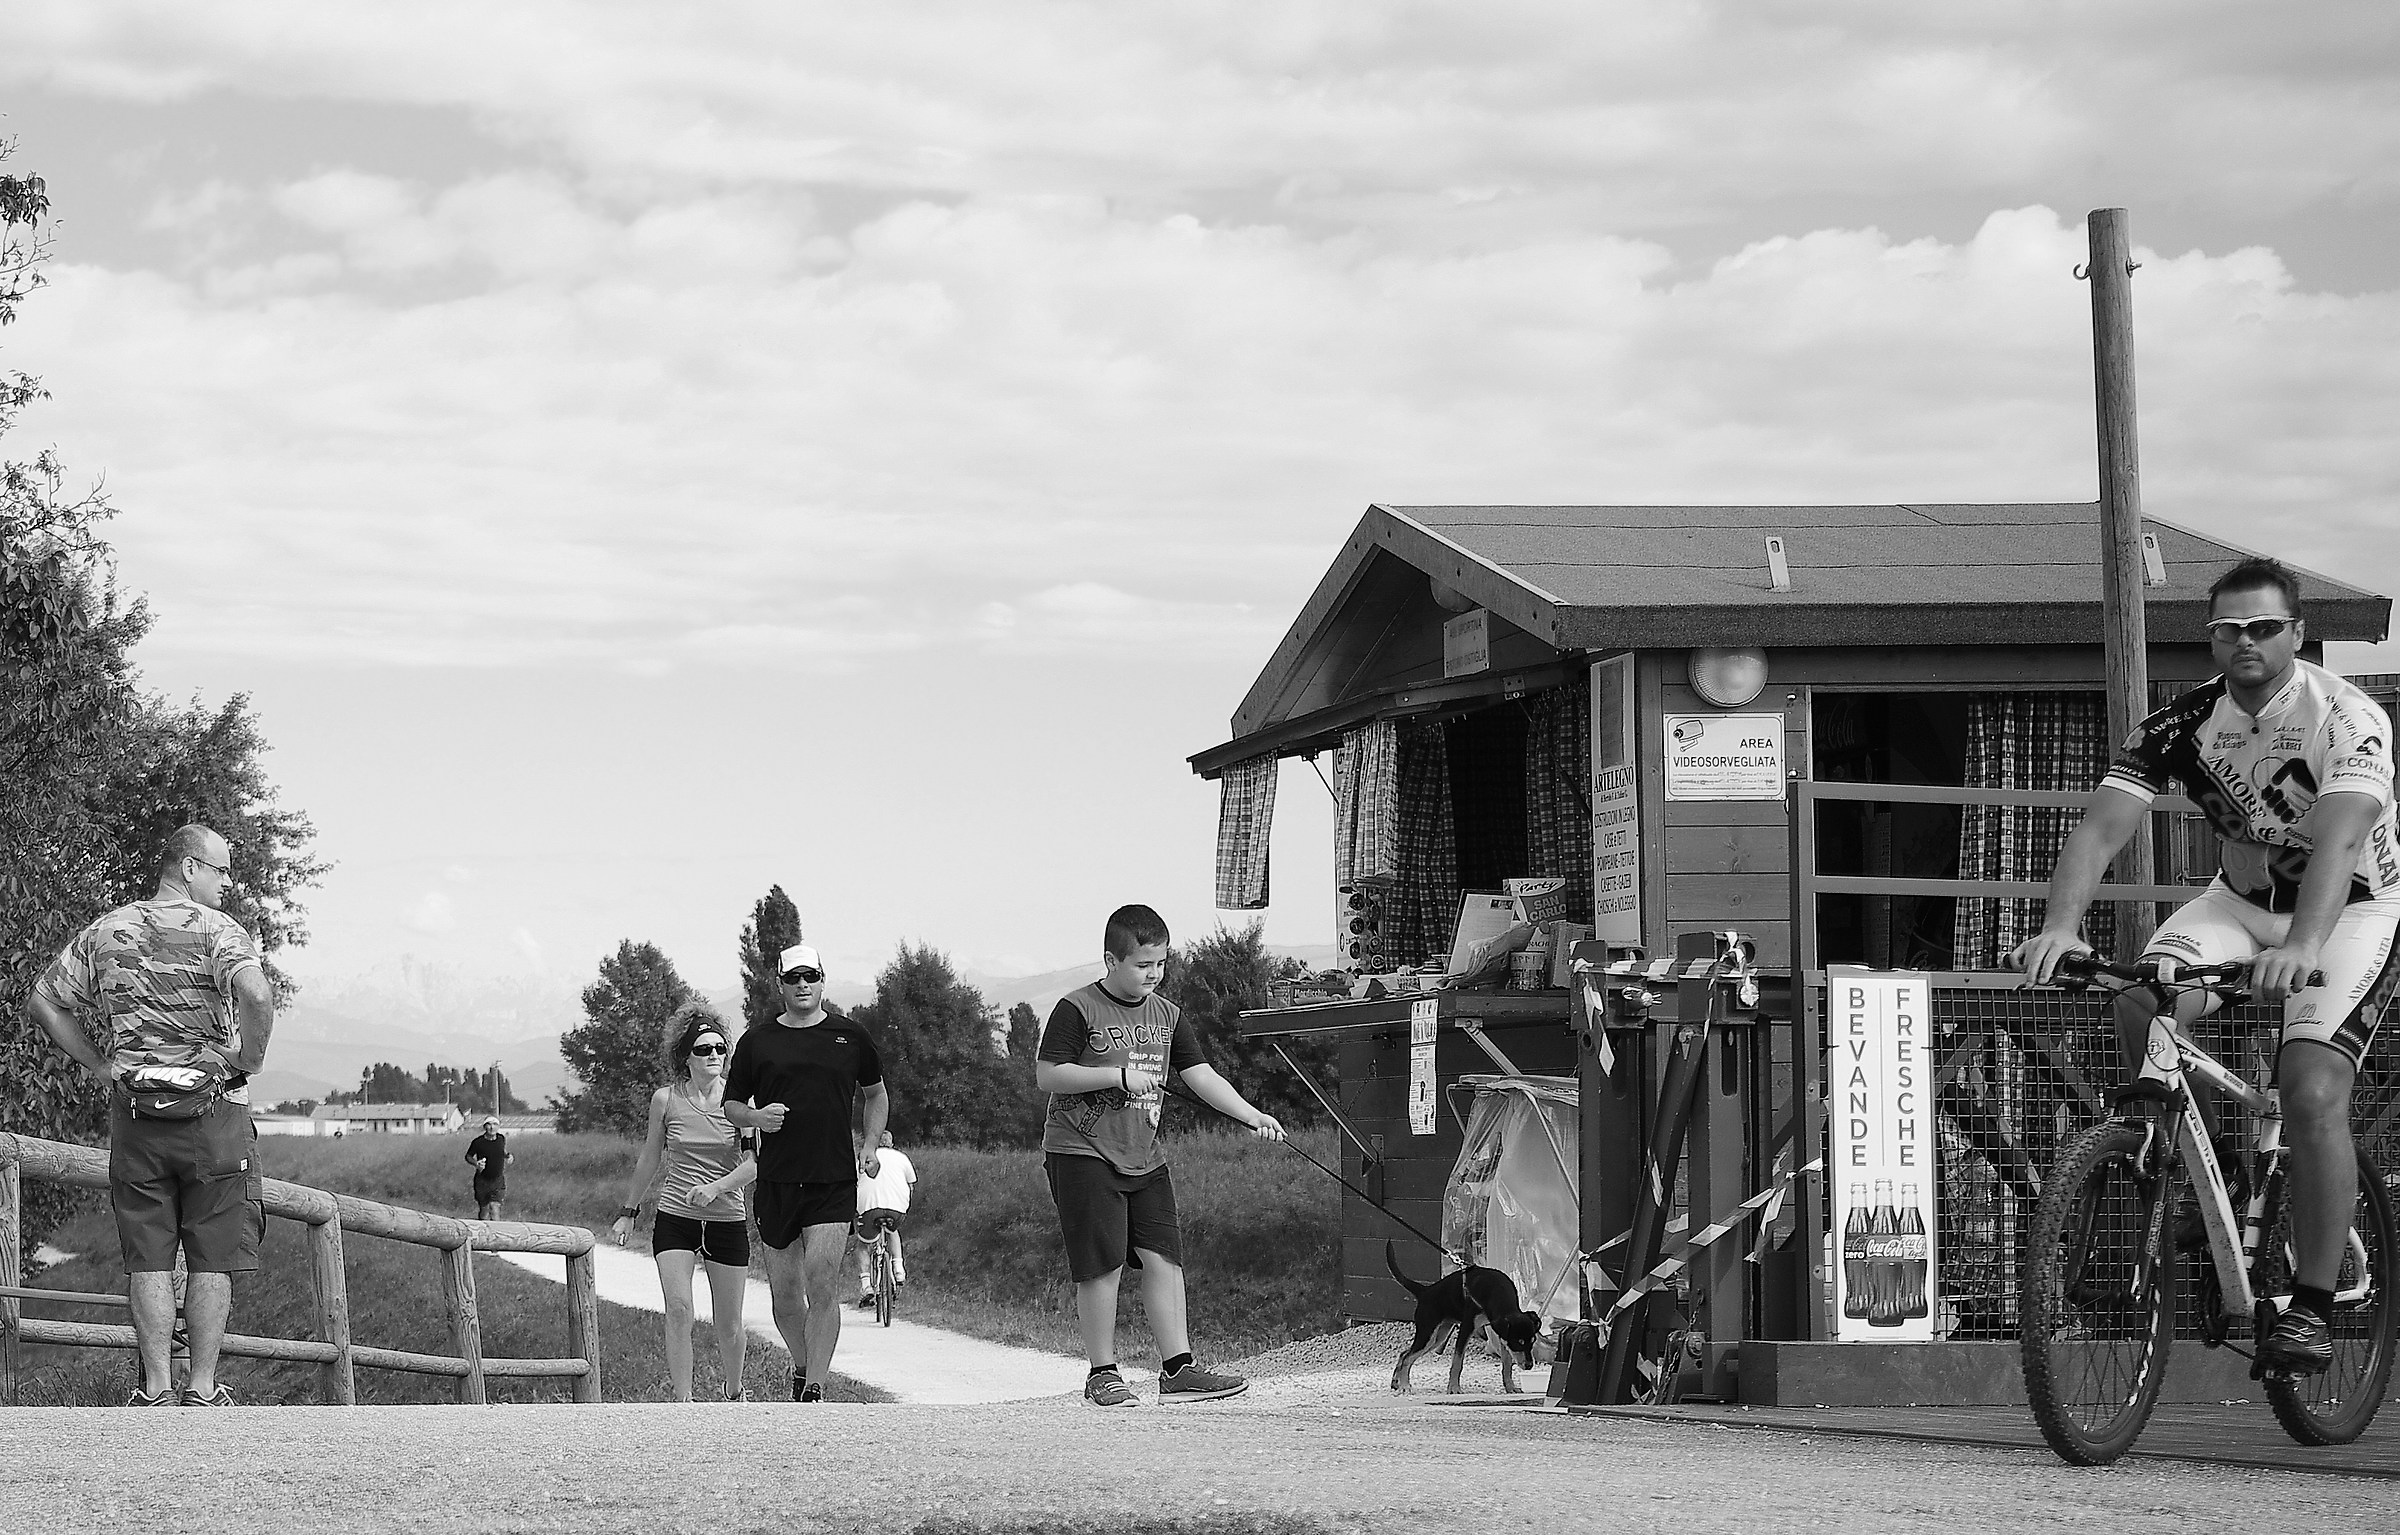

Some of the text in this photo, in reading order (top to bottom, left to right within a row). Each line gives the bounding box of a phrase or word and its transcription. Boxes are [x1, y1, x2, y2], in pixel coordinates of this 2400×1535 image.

[1739, 738, 1774, 749] AREA
[1673, 756, 1777, 768] VIDEOSORVEGLIATA
[1594, 765, 1634, 794] ARTELEGNO
[2207, 755, 2267, 823] AMORE
[1519, 881, 1558, 895] Party
[1534, 895, 1560, 910] SAN
[1529, 903, 1567, 921] CARLO
[1087, 1024, 1174, 1054] CRICKE
[1128, 1051, 1164, 1062] GRIP FOR
[1128, 1062, 1163, 1072] IN SWING
[134, 1066, 207, 1087] NIKE
[1848, 987, 1868, 1167] BEVANDE
[1896, 987, 1915, 1167] FRESCHE
[1124, 1101, 1142, 1110] FINE
[1845, 1251, 1865, 1259] zero
